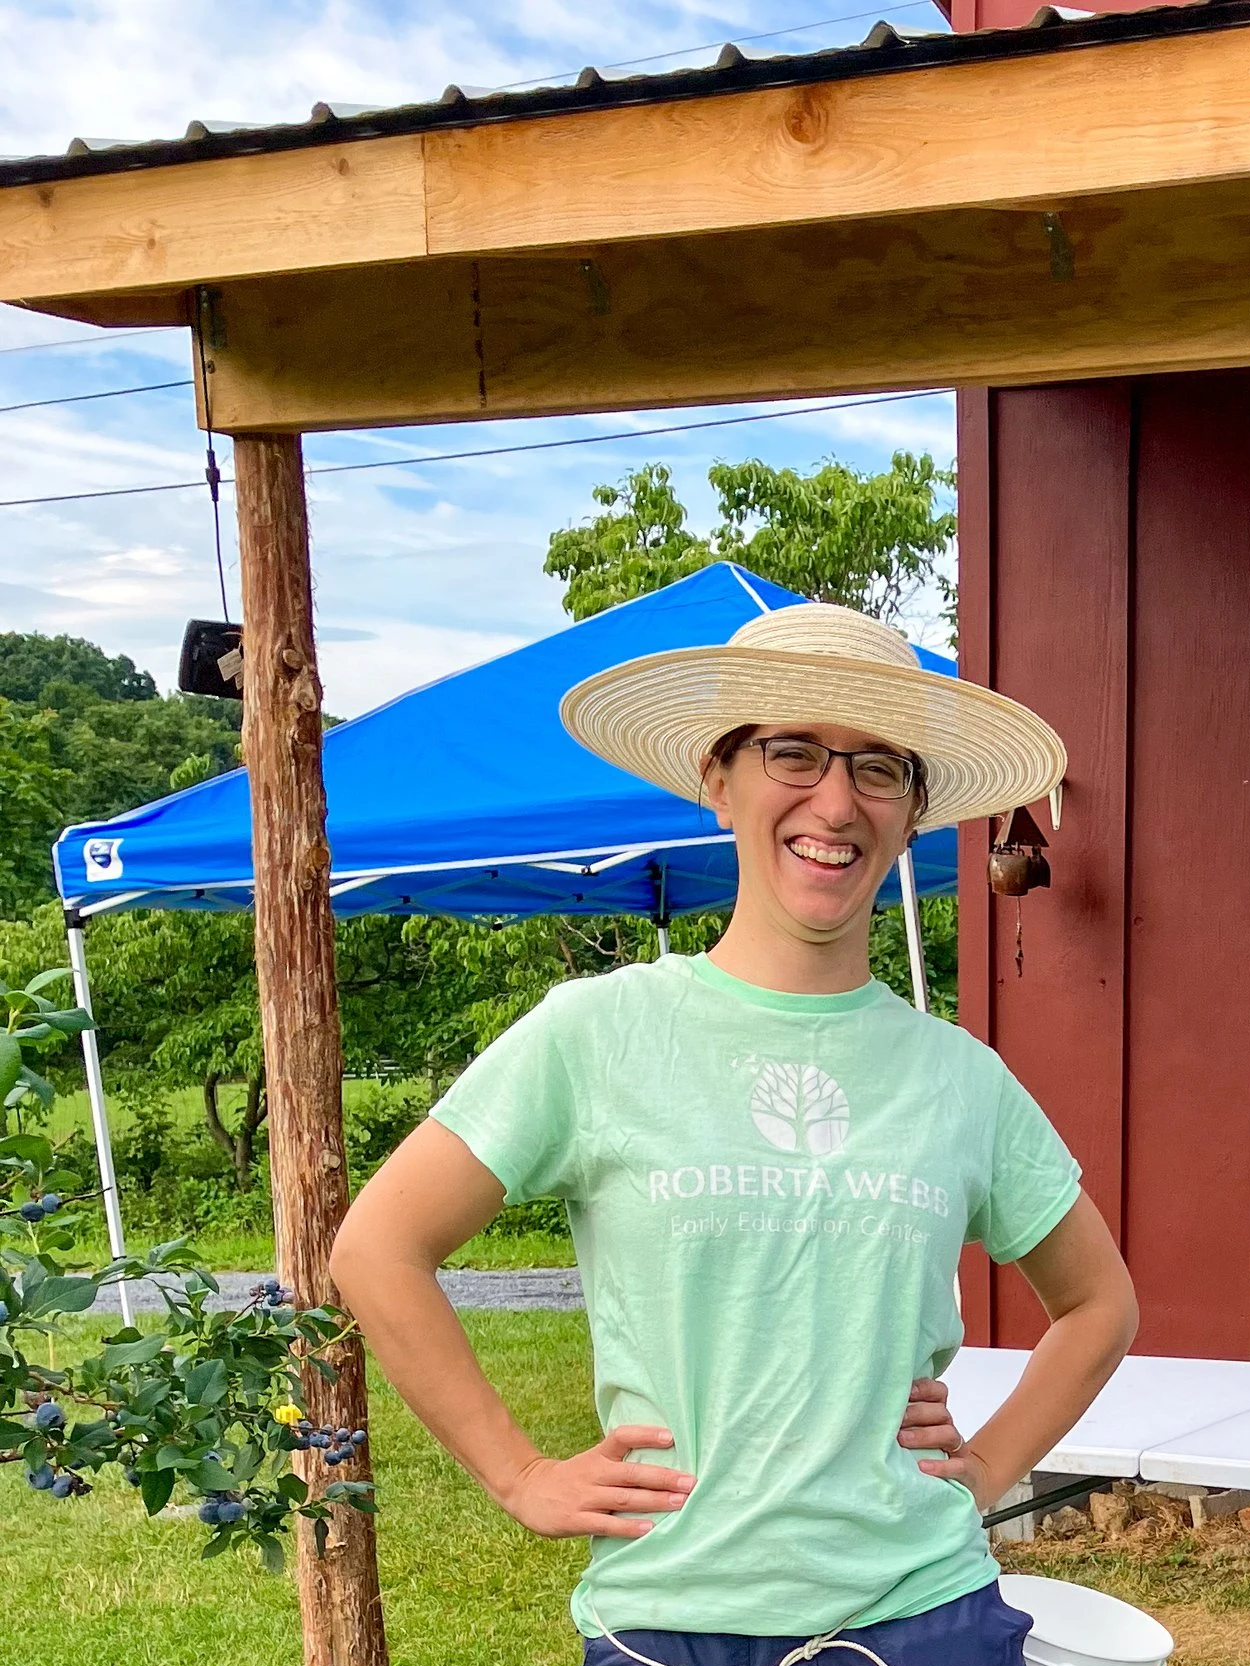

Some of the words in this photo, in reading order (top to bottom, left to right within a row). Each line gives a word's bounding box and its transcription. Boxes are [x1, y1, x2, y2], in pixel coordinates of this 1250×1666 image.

[649, 1163, 835, 1204] ROBERTA
[844, 1170, 950, 1218] WEBB
[669, 1212, 730, 1240] Early
[737, 1212, 851, 1236] Education
[859, 1216, 931, 1245] Center
